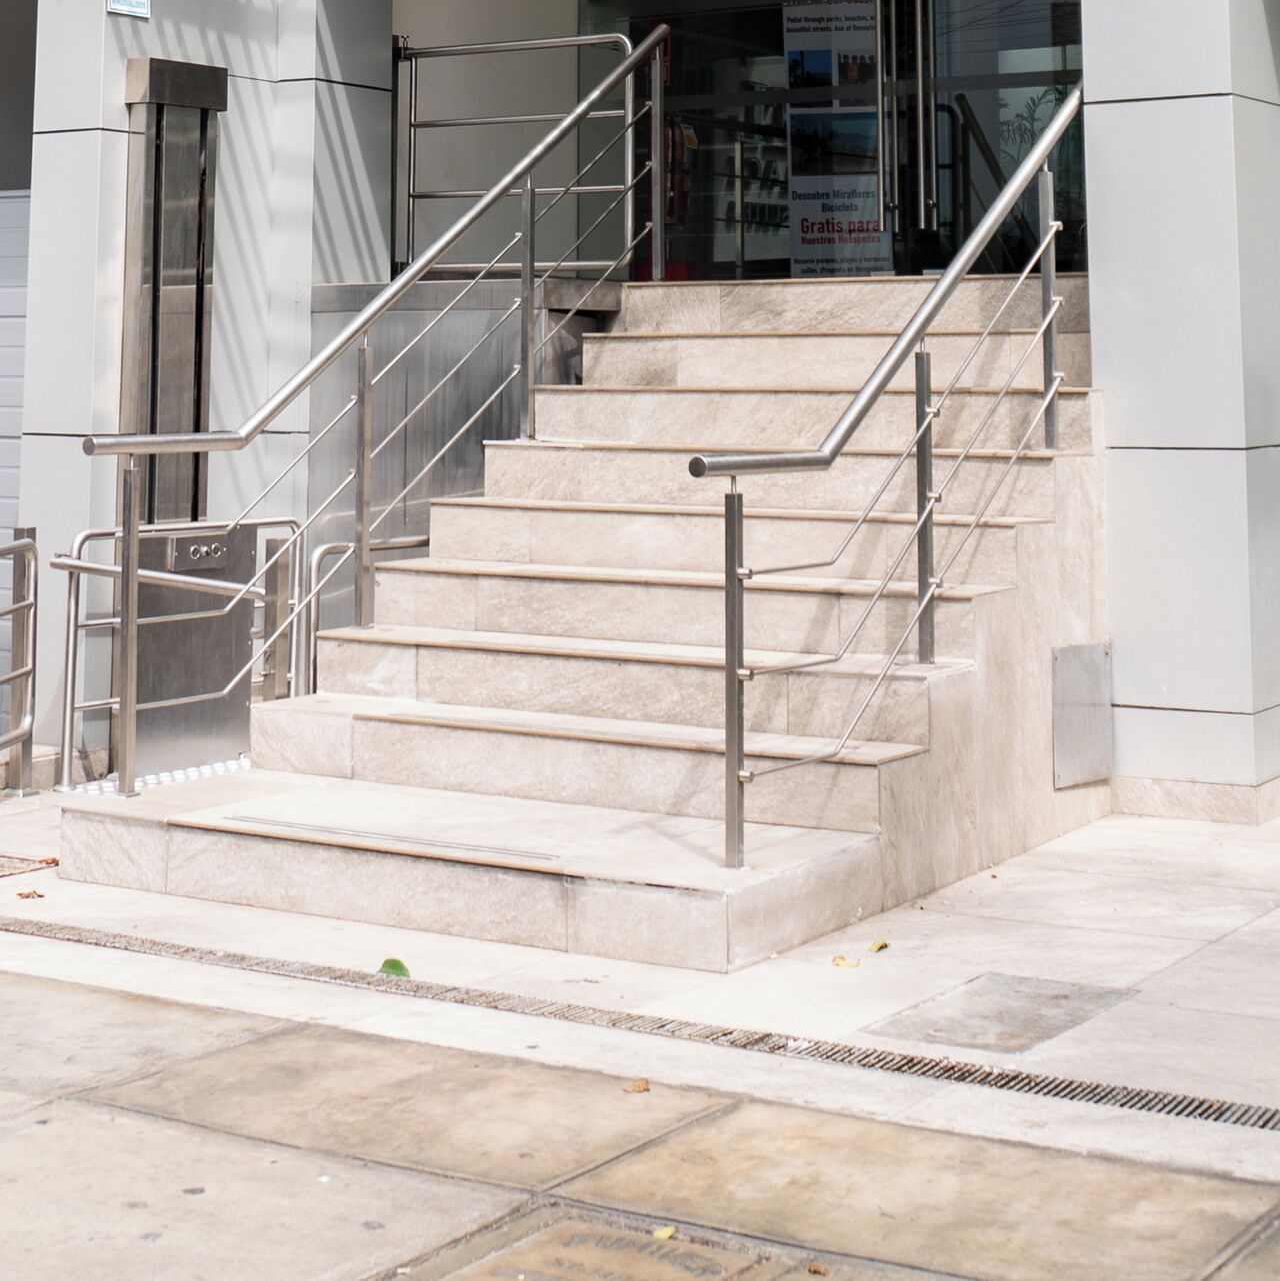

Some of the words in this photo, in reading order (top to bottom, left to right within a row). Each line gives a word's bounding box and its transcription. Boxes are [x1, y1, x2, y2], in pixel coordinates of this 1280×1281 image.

[792, 190, 830, 201] Descubre
[832, 188, 876, 200] Miraflores
[822, 202, 859, 213] Bicicleta
[800, 217, 843, 234] Gratis
[848, 218, 881, 236] para
[801, 235, 836, 246] Nuestros
